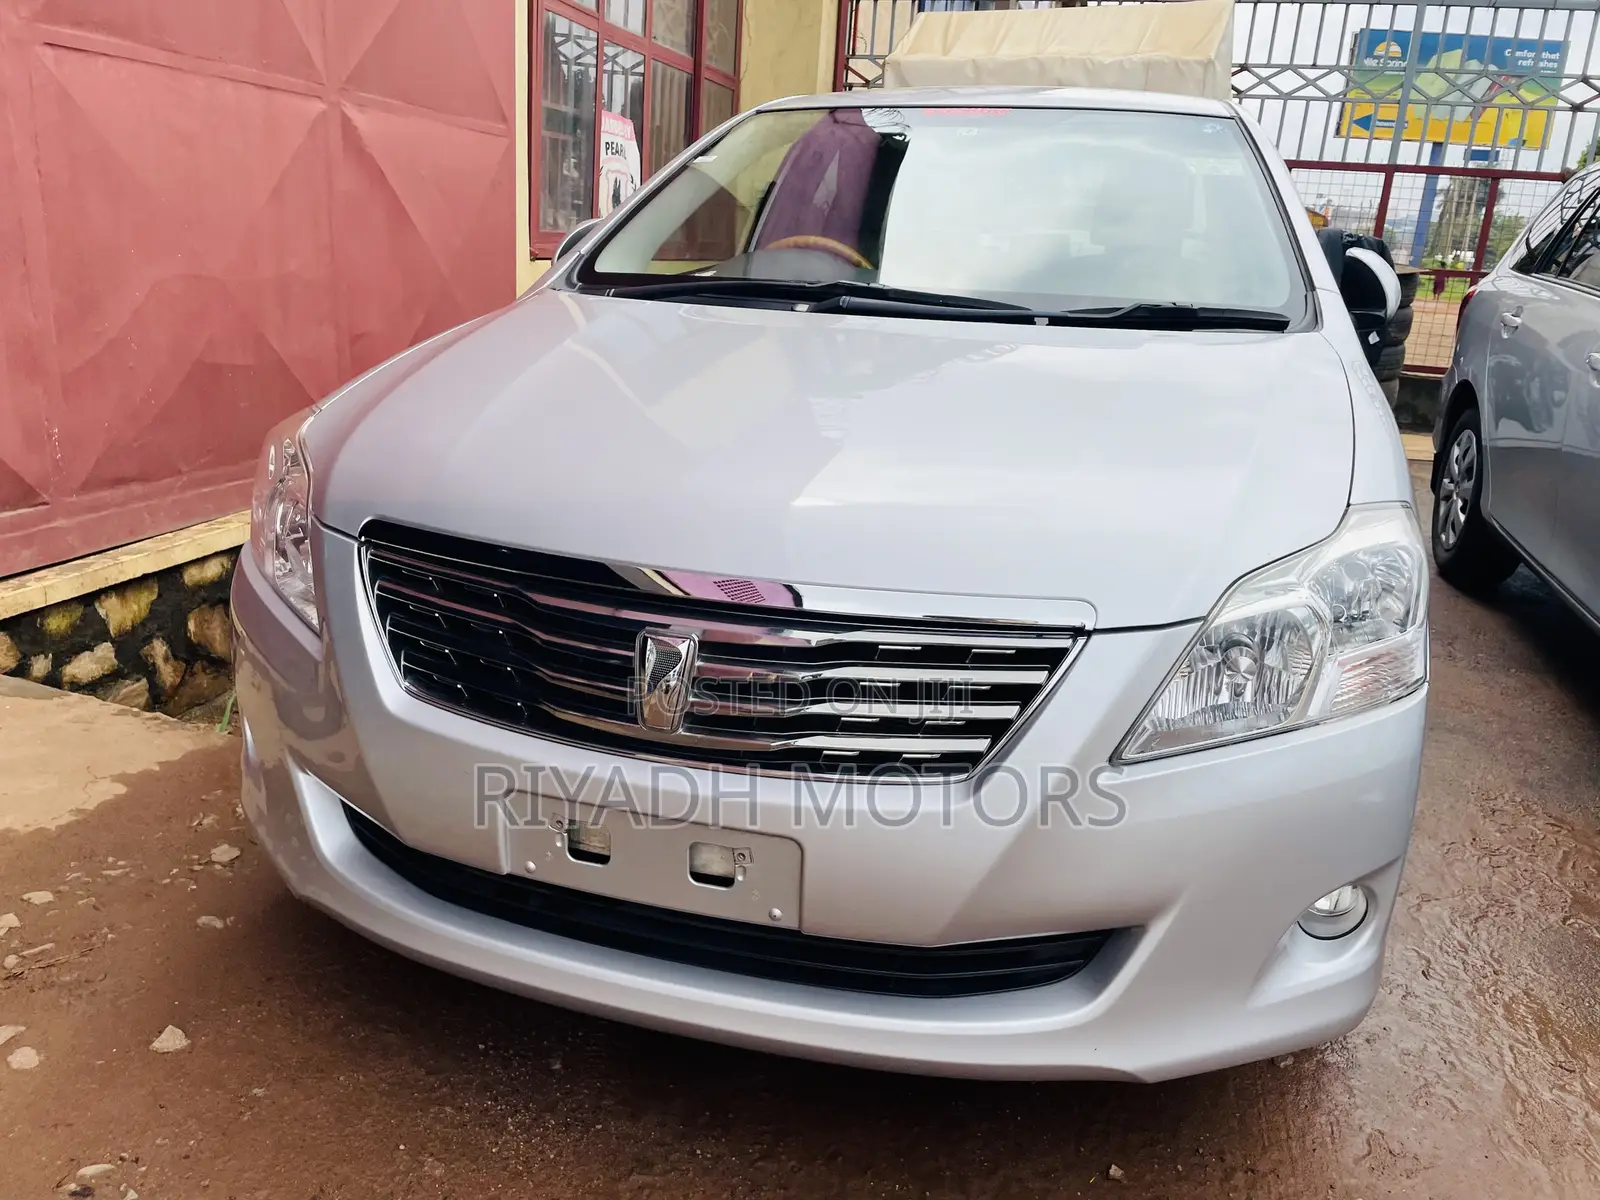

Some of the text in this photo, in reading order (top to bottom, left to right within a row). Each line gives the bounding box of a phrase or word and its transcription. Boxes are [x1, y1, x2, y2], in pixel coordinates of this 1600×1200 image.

[1504, 48, 1561, 60] Cmfor that
[1517, 59, 1559, 68] refrshes
